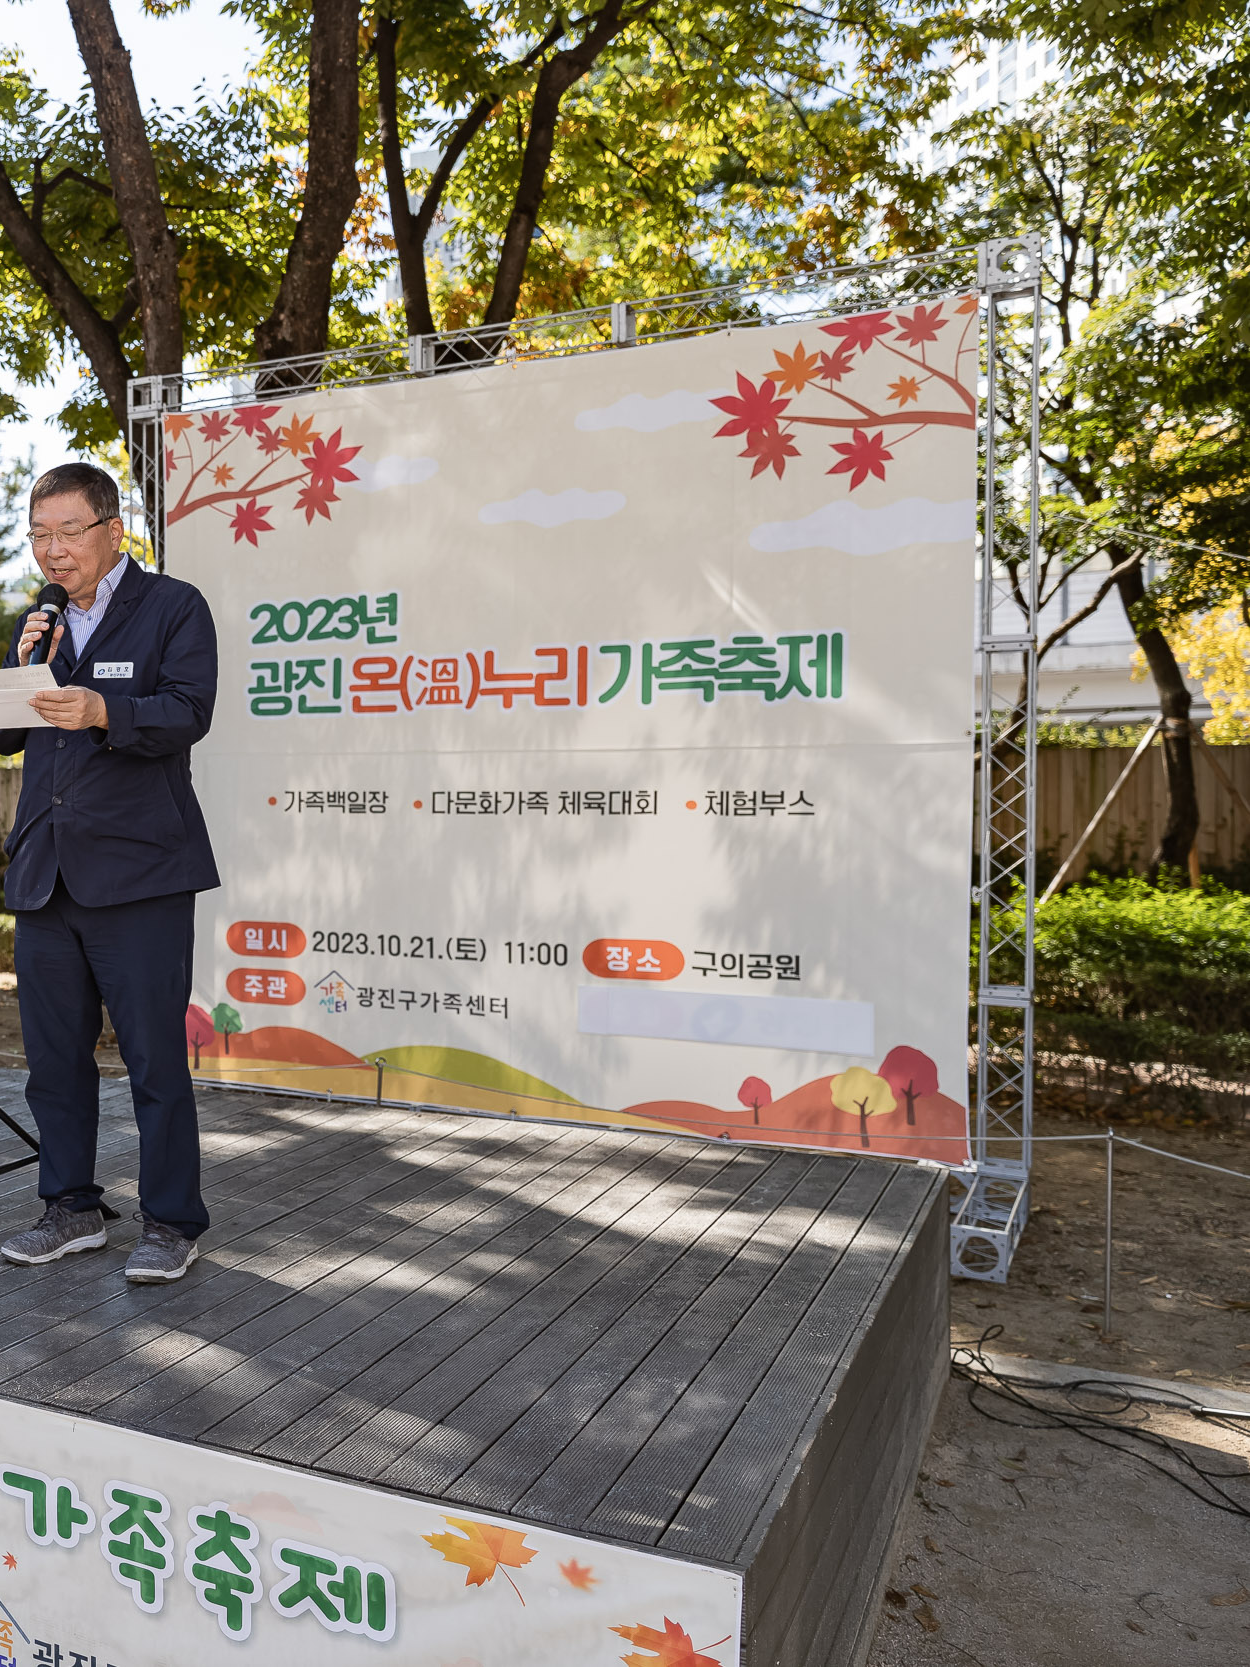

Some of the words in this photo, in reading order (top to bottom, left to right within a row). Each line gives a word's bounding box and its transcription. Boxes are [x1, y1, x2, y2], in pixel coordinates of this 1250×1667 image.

[249, 592, 398, 645] 2023년
[284, 790, 390, 815] 가족백일장
[432, 790, 550, 816] 다문화가족
[557, 789, 659, 817] 체육대회
[704, 790, 816, 817] 체험부스
[244, 927, 288, 952] 일시
[311, 929, 487, 963] 2023.10.21.(토)
[504, 940, 569, 967] 11:00
[605, 945, 662, 974] 장소
[691, 950, 802, 982] 구의공원
[243, 974, 288, 1000] 주관
[356, 986, 510, 1020] 광진구가족센터
[2, 1470, 387, 1633] 가족축제
